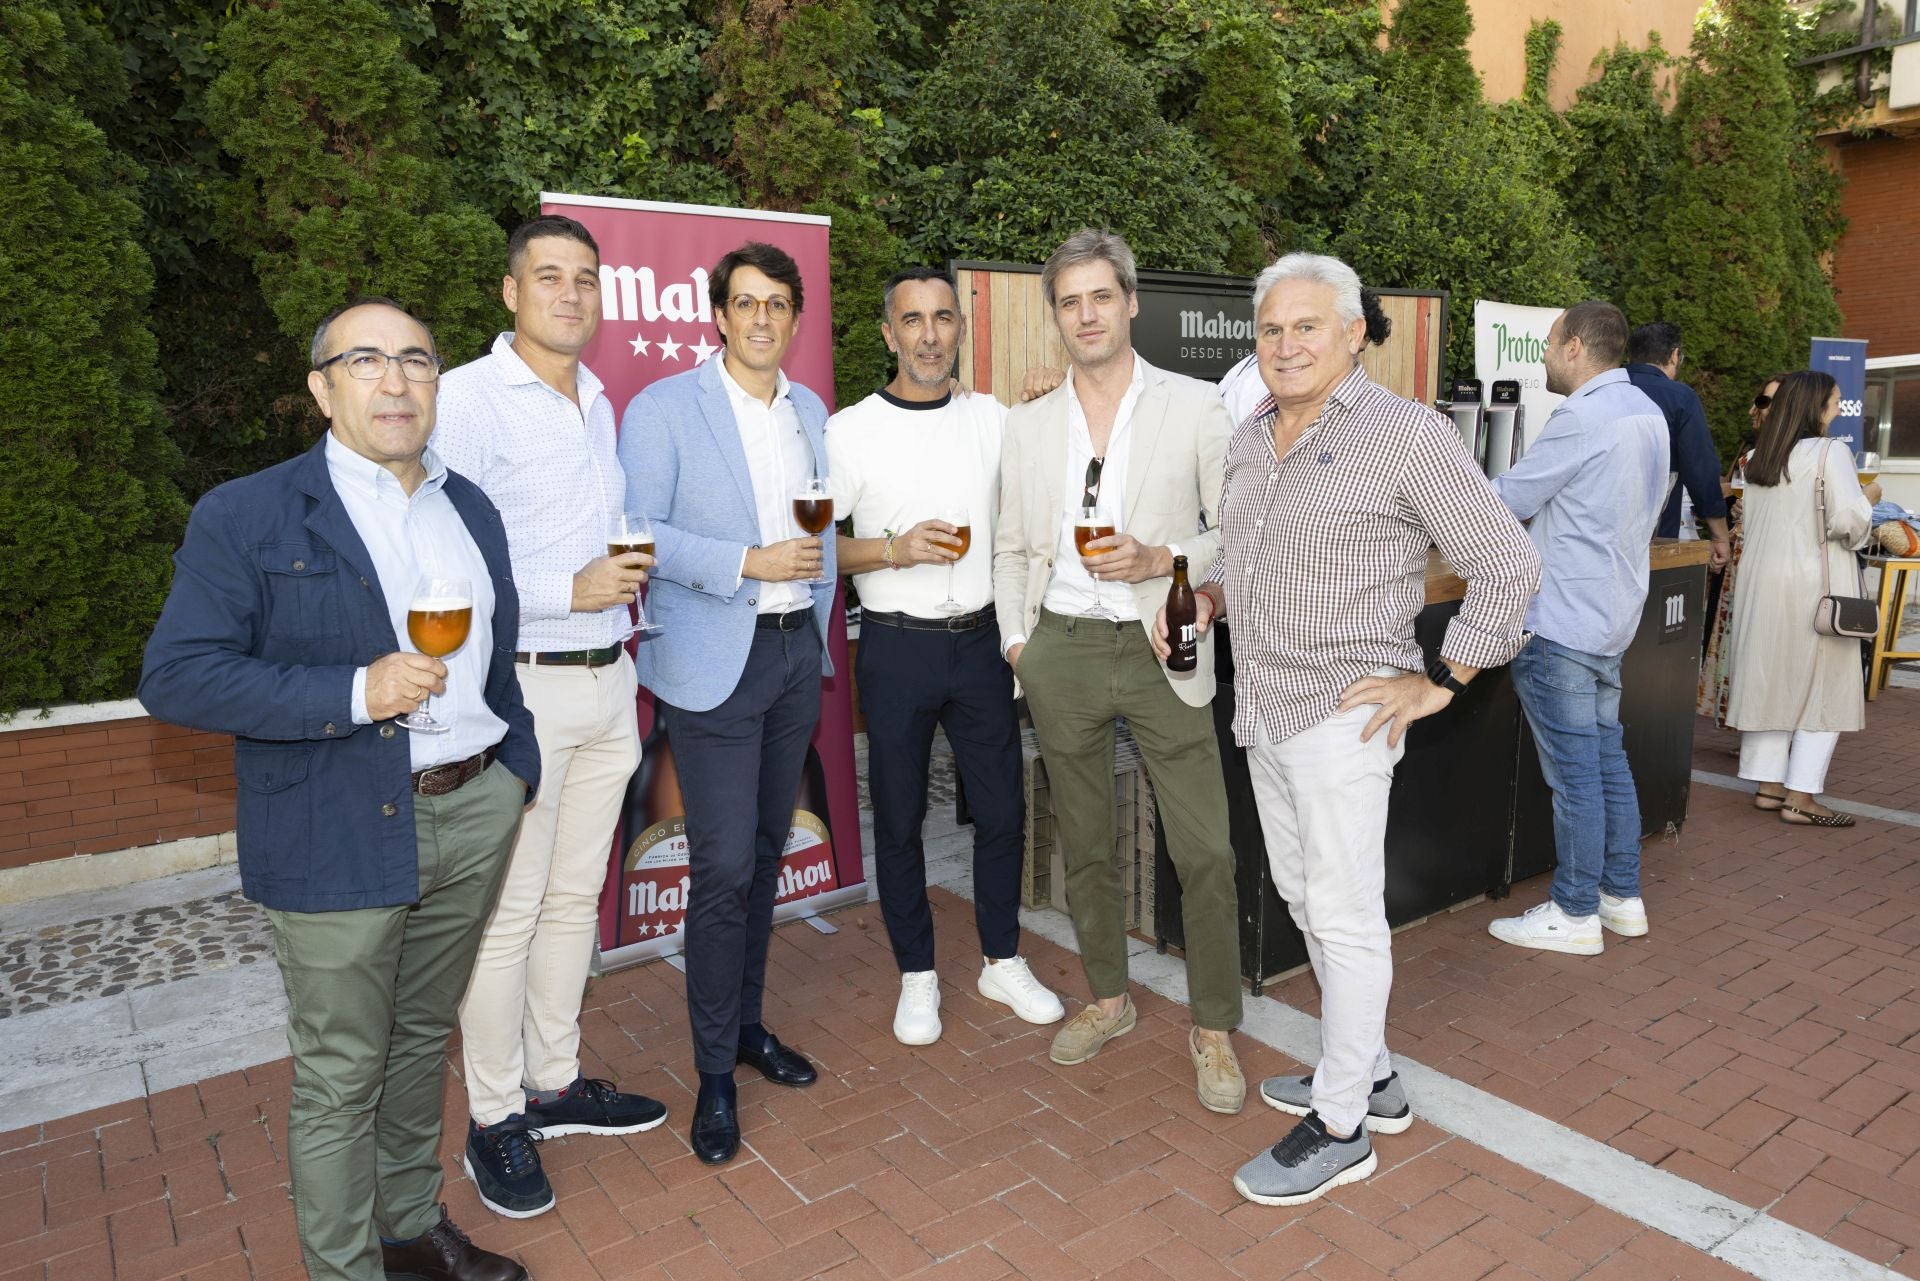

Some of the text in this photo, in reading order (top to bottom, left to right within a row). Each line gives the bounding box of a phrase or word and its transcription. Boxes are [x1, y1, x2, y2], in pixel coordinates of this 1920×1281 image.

[599, 264, 712, 323] Mah
[1181, 347, 1257, 360] DESDE 189
[1492, 323, 1549, 371] Protos
[634, 828, 666, 857] CINCO
[629, 875, 690, 915] Mah
